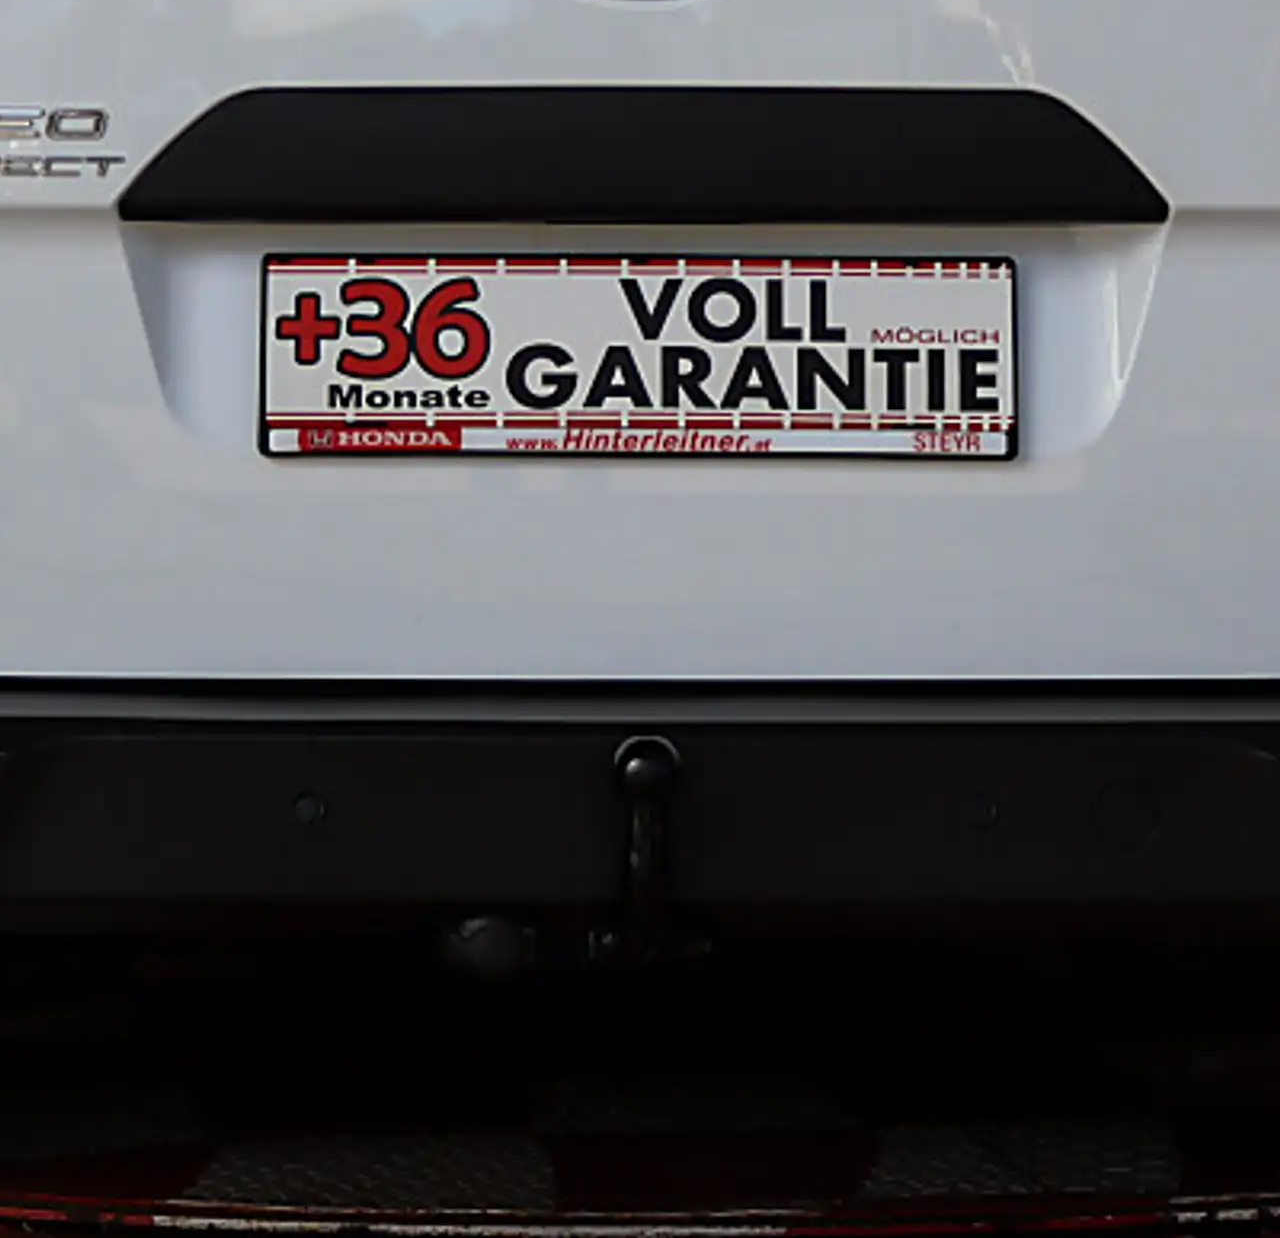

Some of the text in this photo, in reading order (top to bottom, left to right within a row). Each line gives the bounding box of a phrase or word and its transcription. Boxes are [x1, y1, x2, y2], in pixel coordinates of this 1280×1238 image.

[620, 278, 846, 343] VOLL
[276, 277, 491, 378] +36
[871, 327, 1001, 344] MÖGLICH
[506, 344, 1000, 410] GARANTIE
[328, 384, 491, 408] Monate
[337, 427, 453, 447] HONDA
[914, 432, 982, 452] STEYR
